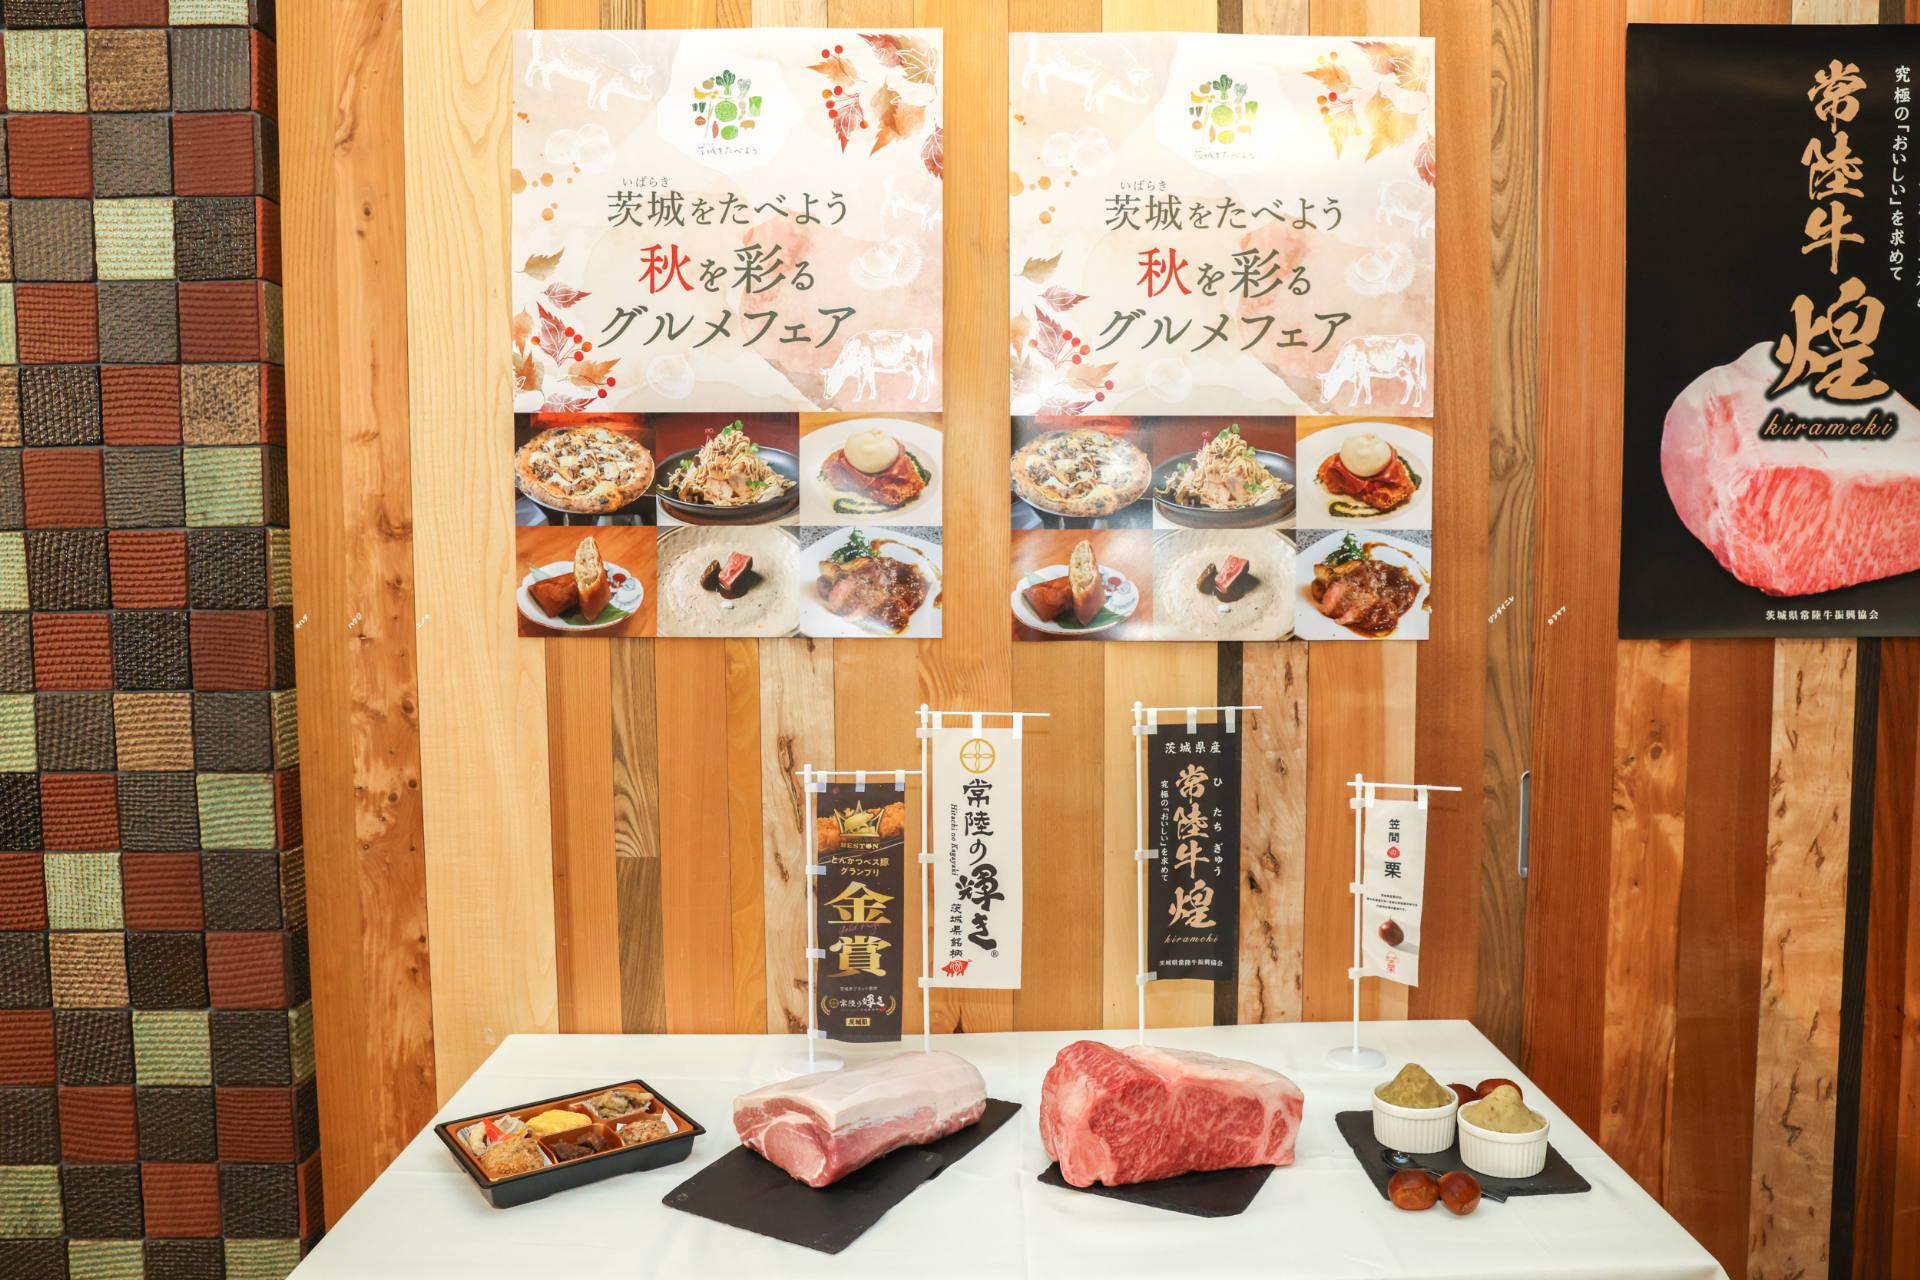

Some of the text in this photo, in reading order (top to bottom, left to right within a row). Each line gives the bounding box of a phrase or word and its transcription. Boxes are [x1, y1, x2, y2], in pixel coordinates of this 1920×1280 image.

[622, 176, 670, 188] いばらき
[1120, 180, 1168, 192] いばらき
[1889, 65, 1911, 281] 究極の「おいしい」を求めて
[607, 191, 848, 227] 茨城をたべよう
[1105, 194, 1342, 231] 茨城をたべよう
[638, 243, 815, 294] 秋を彩る
[1136, 247, 1312, 298] 秋を彩る
[598, 305, 857, 348] グルメフェア
[1096, 309, 1352, 353] グルメフェア
[1764, 414, 1893, 436] kirameki
[1766, 610, 1879, 621] 茨城県常陸牛振興協会
[1165, 741, 1221, 754] 茨城県産
[949, 803, 959, 876] Hitachi no Kagayaki
[1160, 780, 1170, 882] 究極の「おいしい」を求めて
[841, 867, 880, 877] グランプリ
[955, 779, 1005, 950] 常陸の輝き
[824, 881, 895, 977] 金賞
[1164, 933, 1219, 944] kirameki
